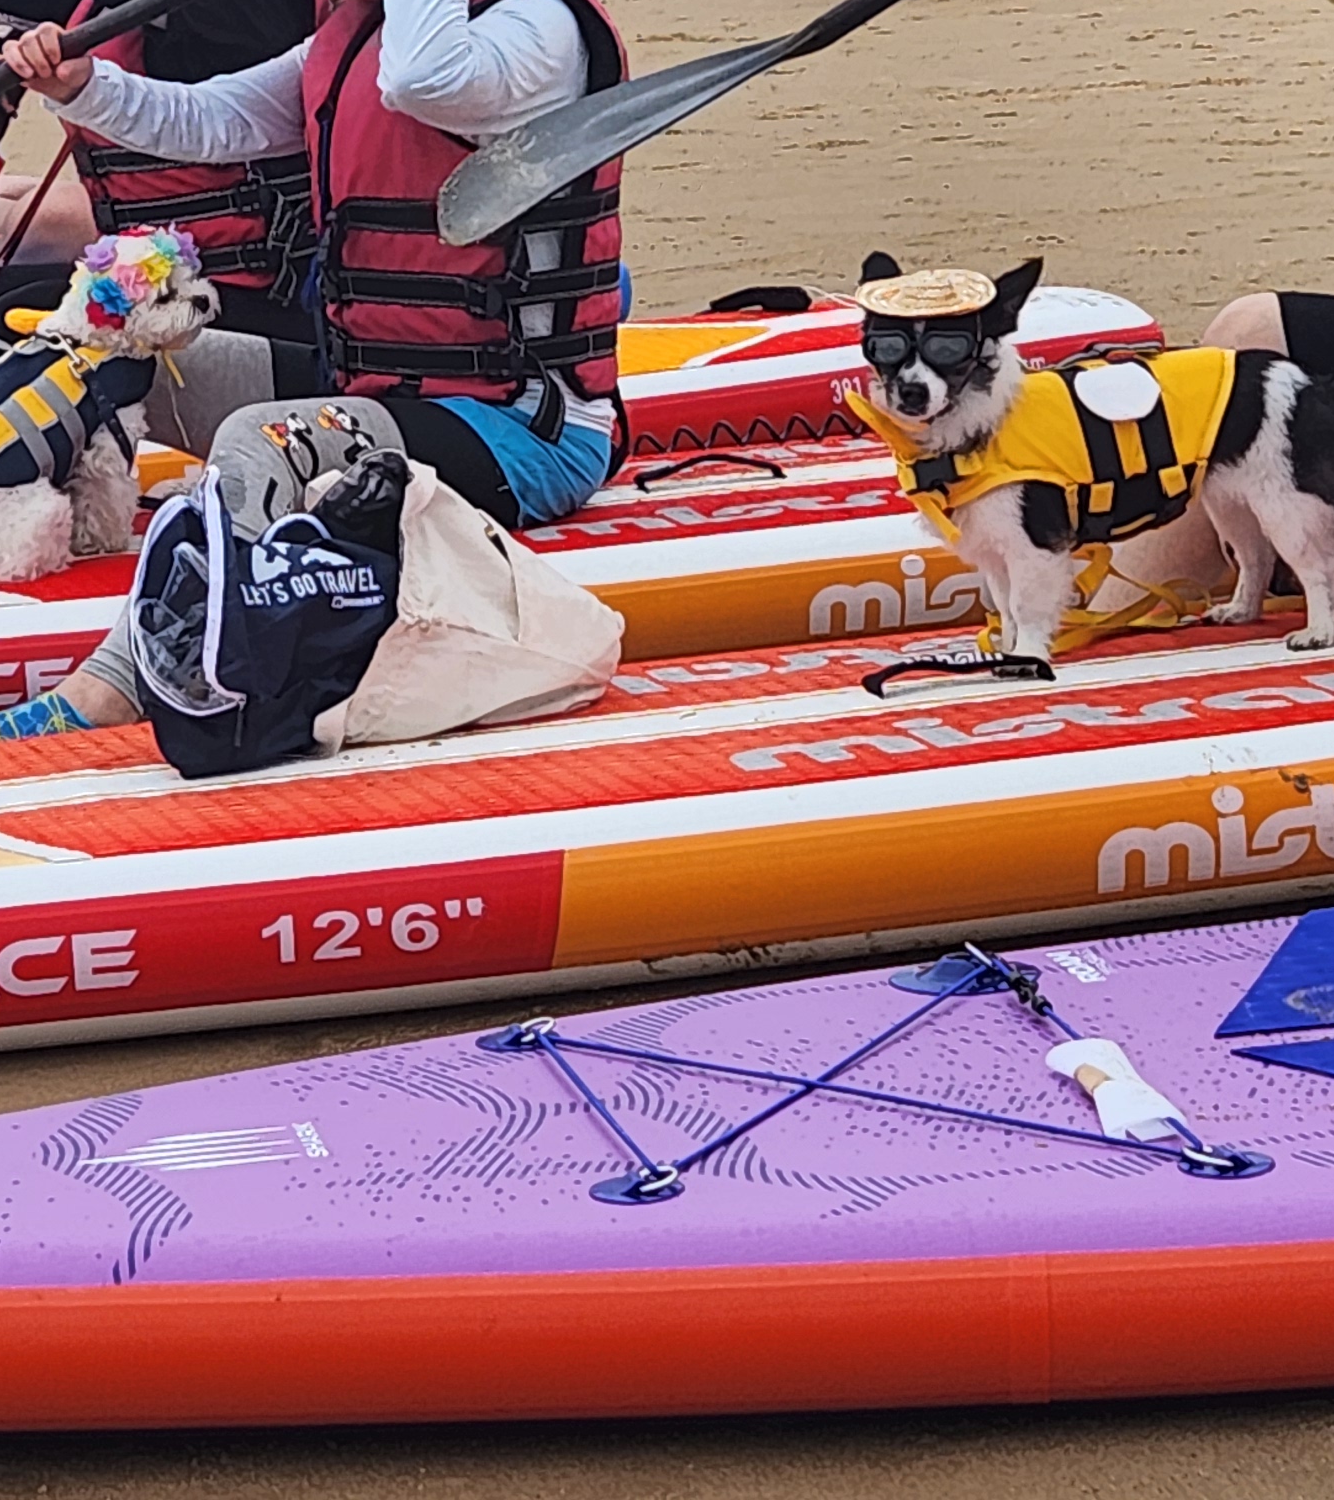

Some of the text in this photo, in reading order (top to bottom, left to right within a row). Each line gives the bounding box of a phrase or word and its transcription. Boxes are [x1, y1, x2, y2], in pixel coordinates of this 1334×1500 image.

[239, 565, 381, 607] LET'S GO TRAVEL
[260, 895, 486, 965] 12'6"
